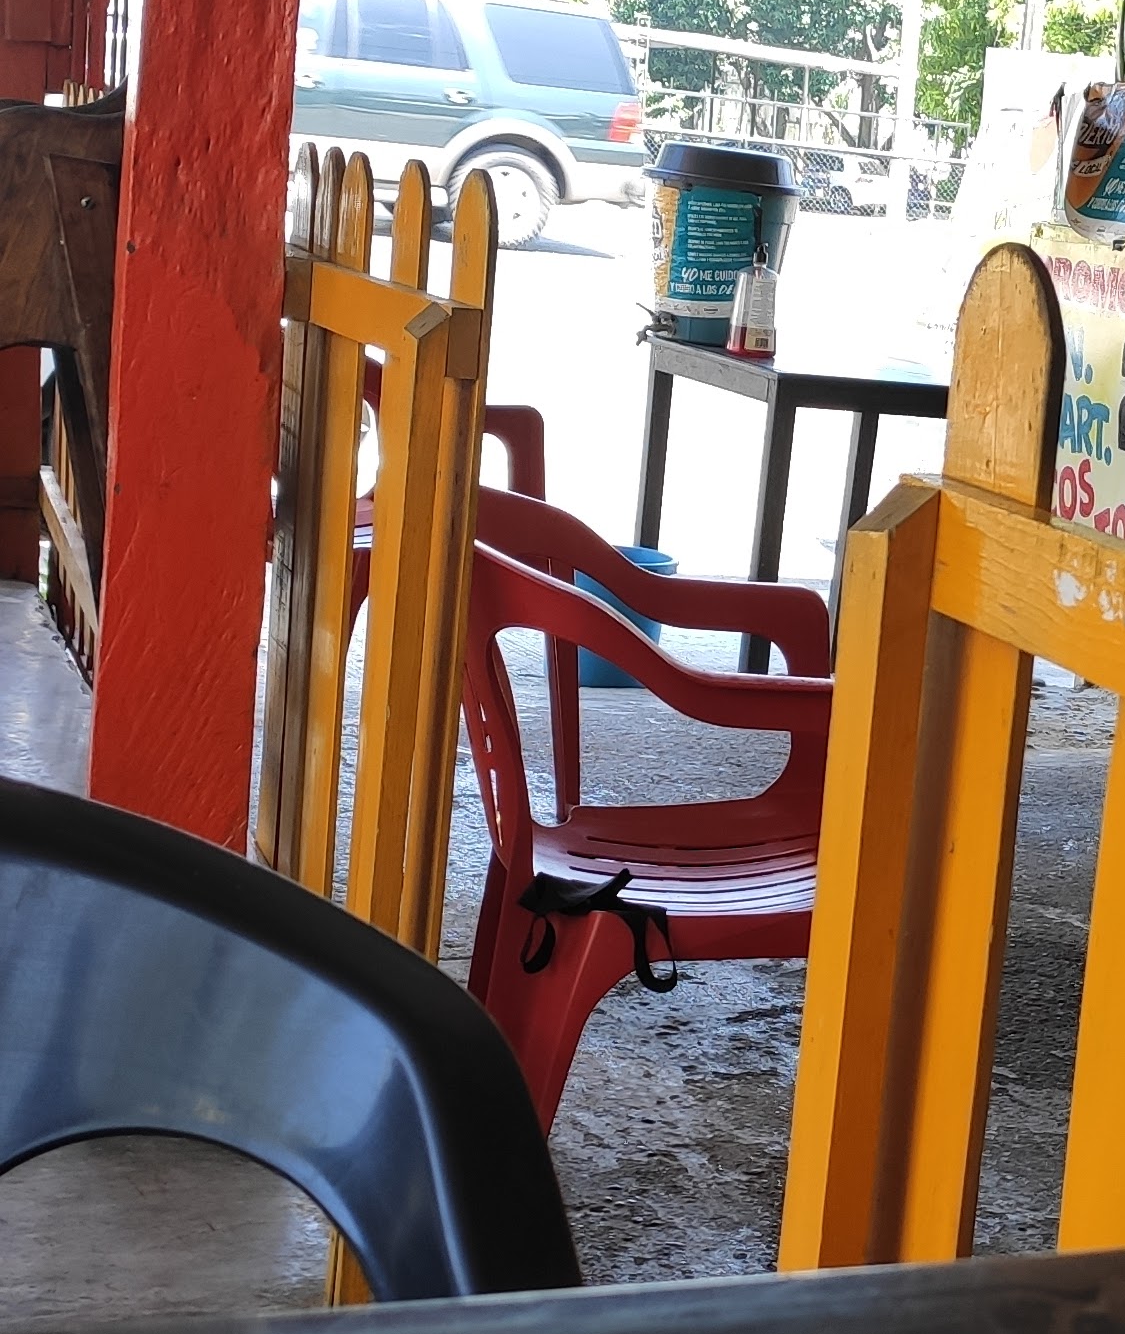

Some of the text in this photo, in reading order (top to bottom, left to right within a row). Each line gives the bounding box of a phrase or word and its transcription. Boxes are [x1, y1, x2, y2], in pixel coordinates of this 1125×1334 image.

[700, 269, 713, 280] ME
[702, 284, 717, 295] LOS
[1051, 458, 1095, 521] OS
